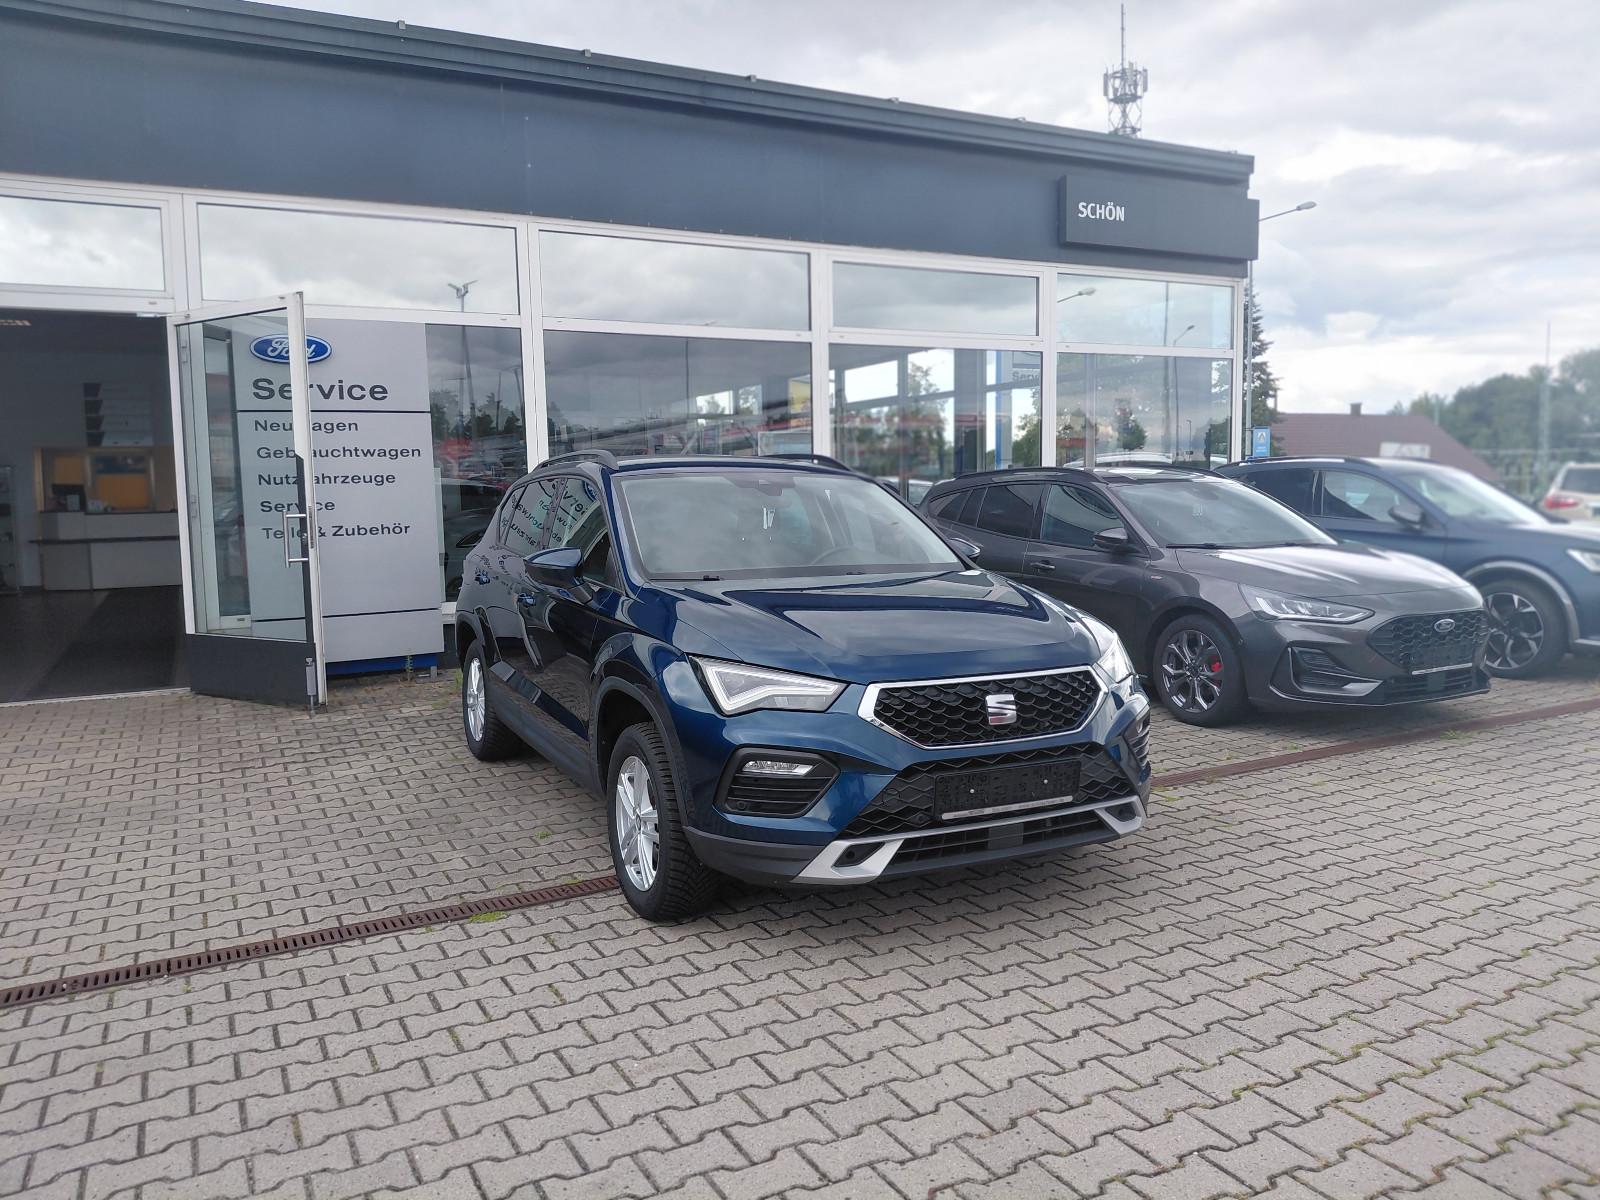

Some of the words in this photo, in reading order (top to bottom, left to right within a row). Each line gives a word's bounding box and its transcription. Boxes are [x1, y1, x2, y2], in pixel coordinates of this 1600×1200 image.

[1078, 201, 1125, 222] SCHÖN
[252, 378, 388, 400] Sevice
[254, 420, 358, 434] Neuagen
[257, 446, 421, 460] Gebauchtwagen
[258, 473, 396, 486] Nutzahrzeuge
[260, 501, 335, 512] Servce
[262, 527, 303, 539] Tel
[332, 523, 410, 537] Zubehör
